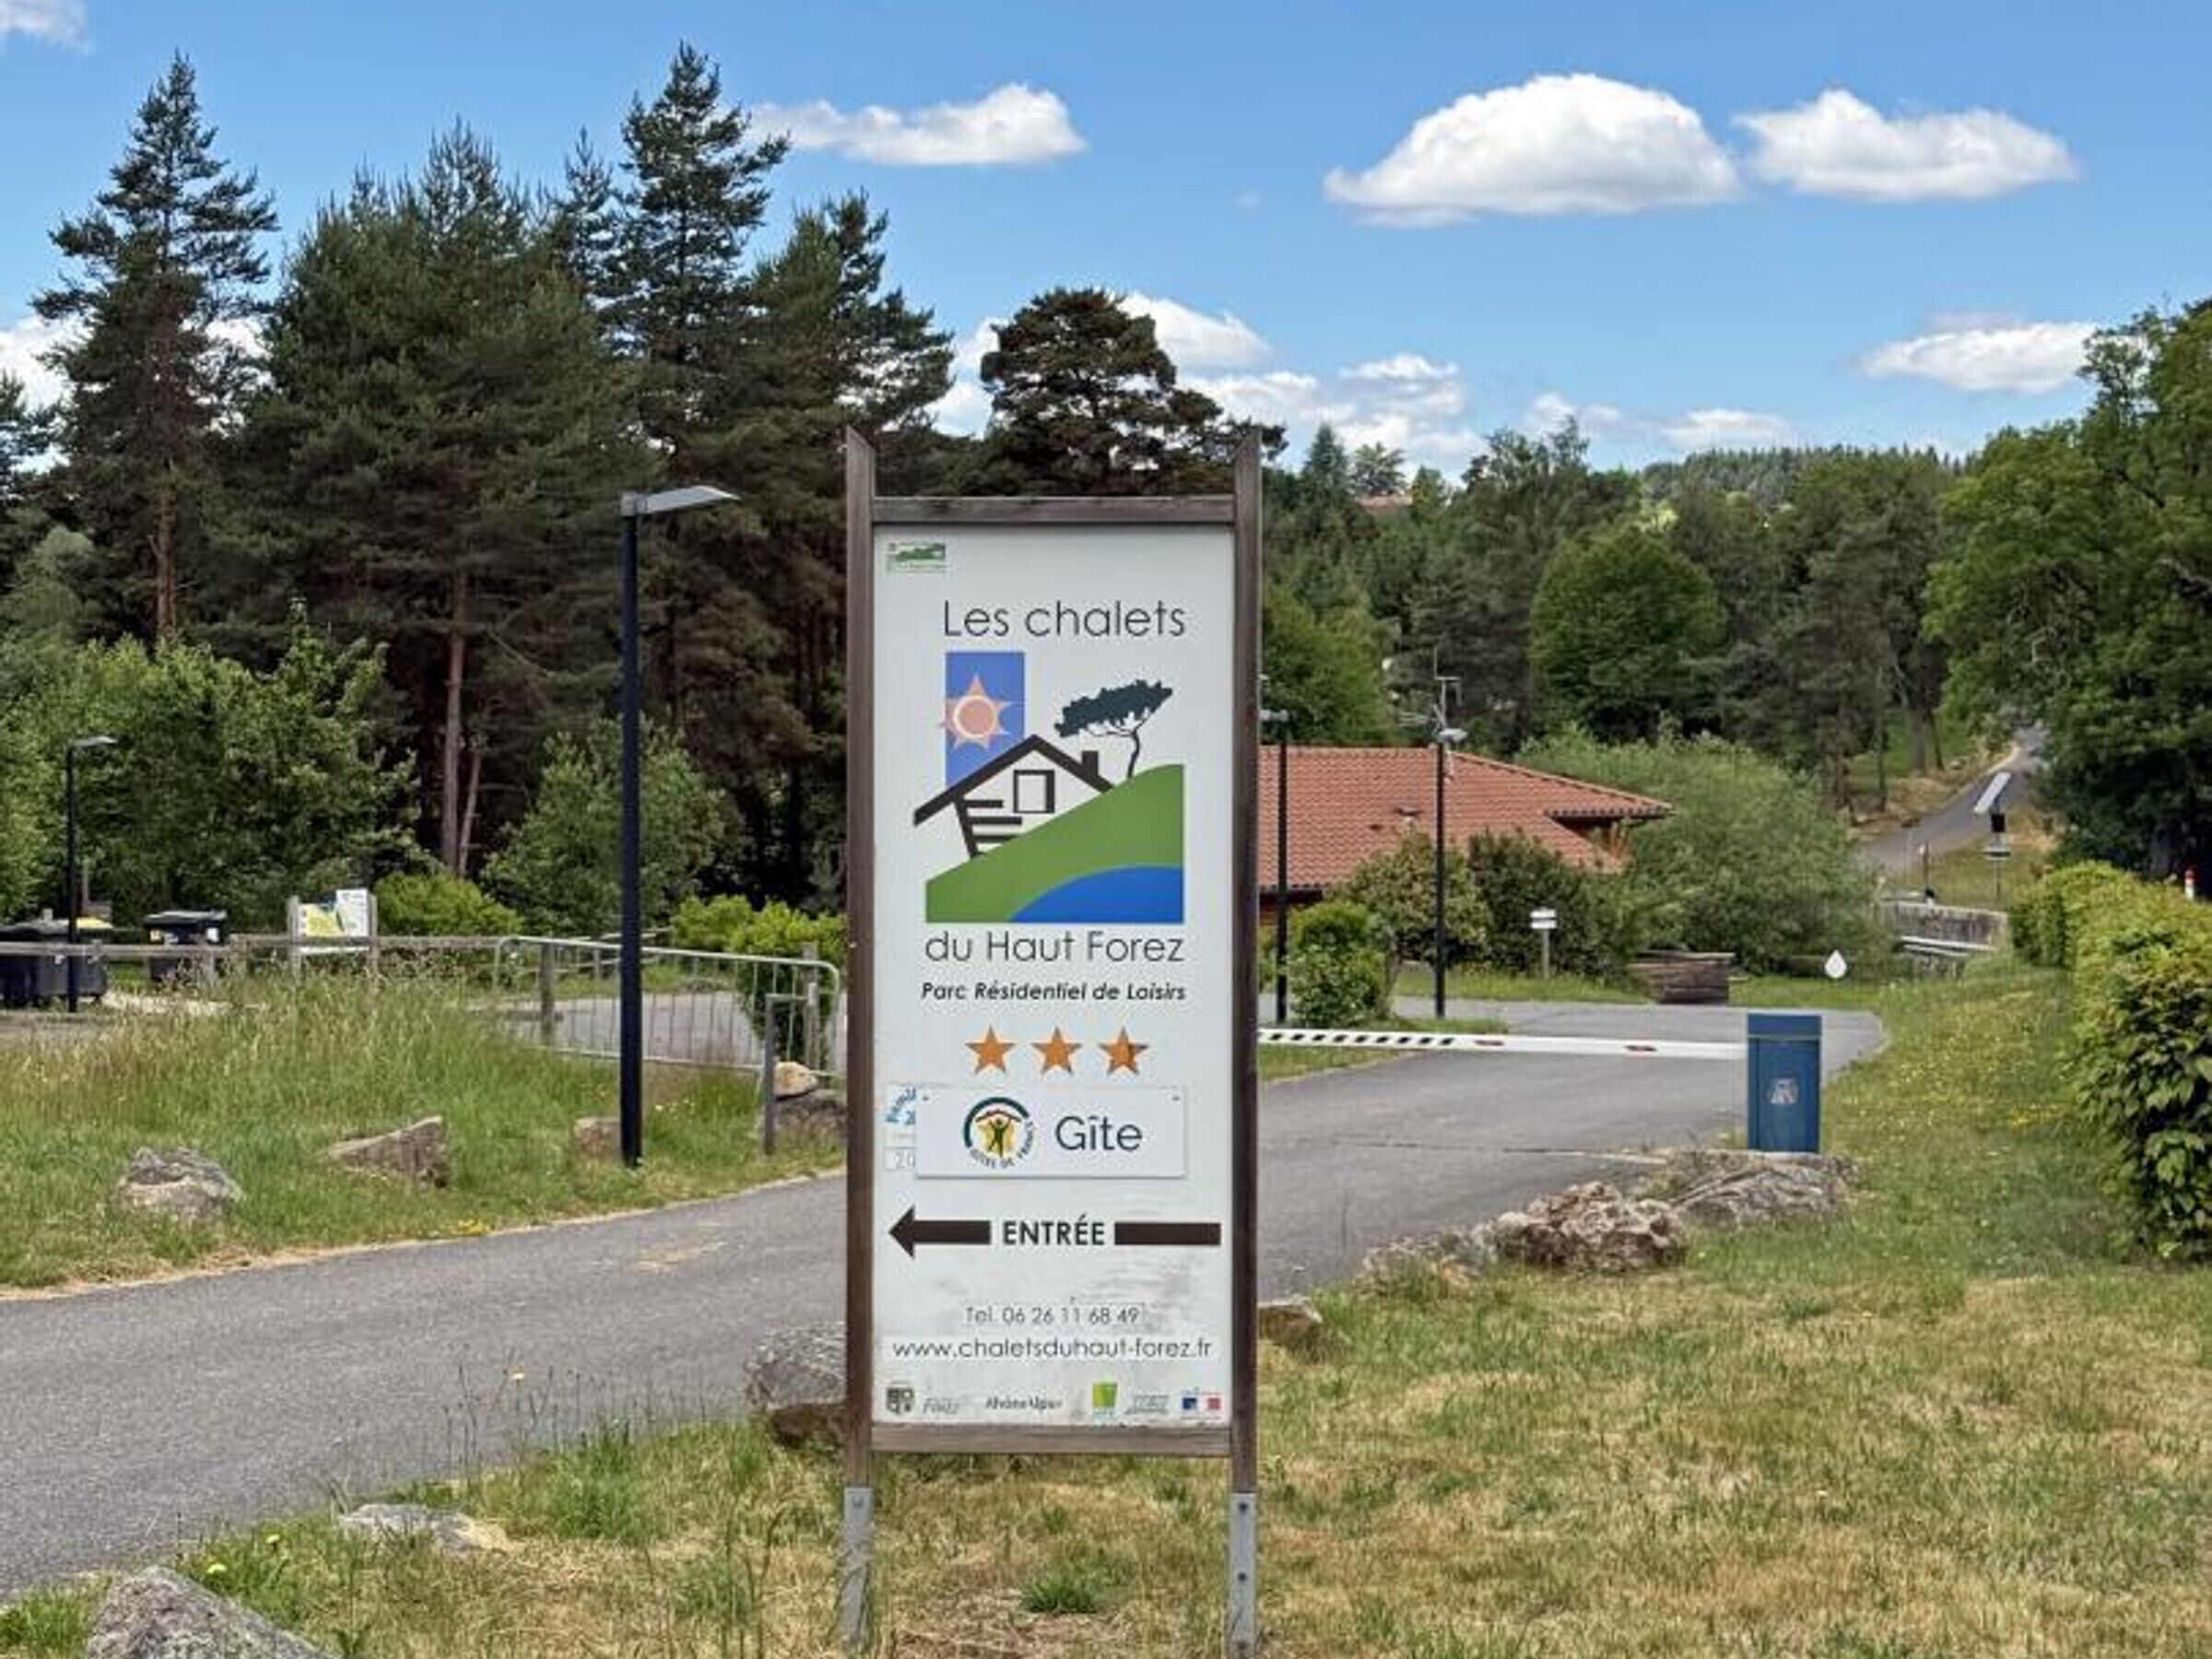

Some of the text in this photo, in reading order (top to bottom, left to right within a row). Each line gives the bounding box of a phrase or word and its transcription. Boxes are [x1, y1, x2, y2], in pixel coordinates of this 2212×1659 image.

[944, 599, 1186, 638] Les chalets
[924, 931, 1185, 962] du Haut Forez
[921, 980, 1186, 1001] Parc Résidentiel de Loisirs
[1054, 1115, 1144, 1151] Gîte
[1003, 1213, 1105, 1246] ENTRÉE
[1002, 1307, 1026, 1324] 06
[1031, 1307, 1054, 1324] 26
[1062, 1307, 1080, 1324] 11
[1088, 1307, 1112, 1324] 68
[1116, 1307, 1140, 1324] 49
[892, 1337, 1212, 1359] www.chaletsduhaut-forez.fr
